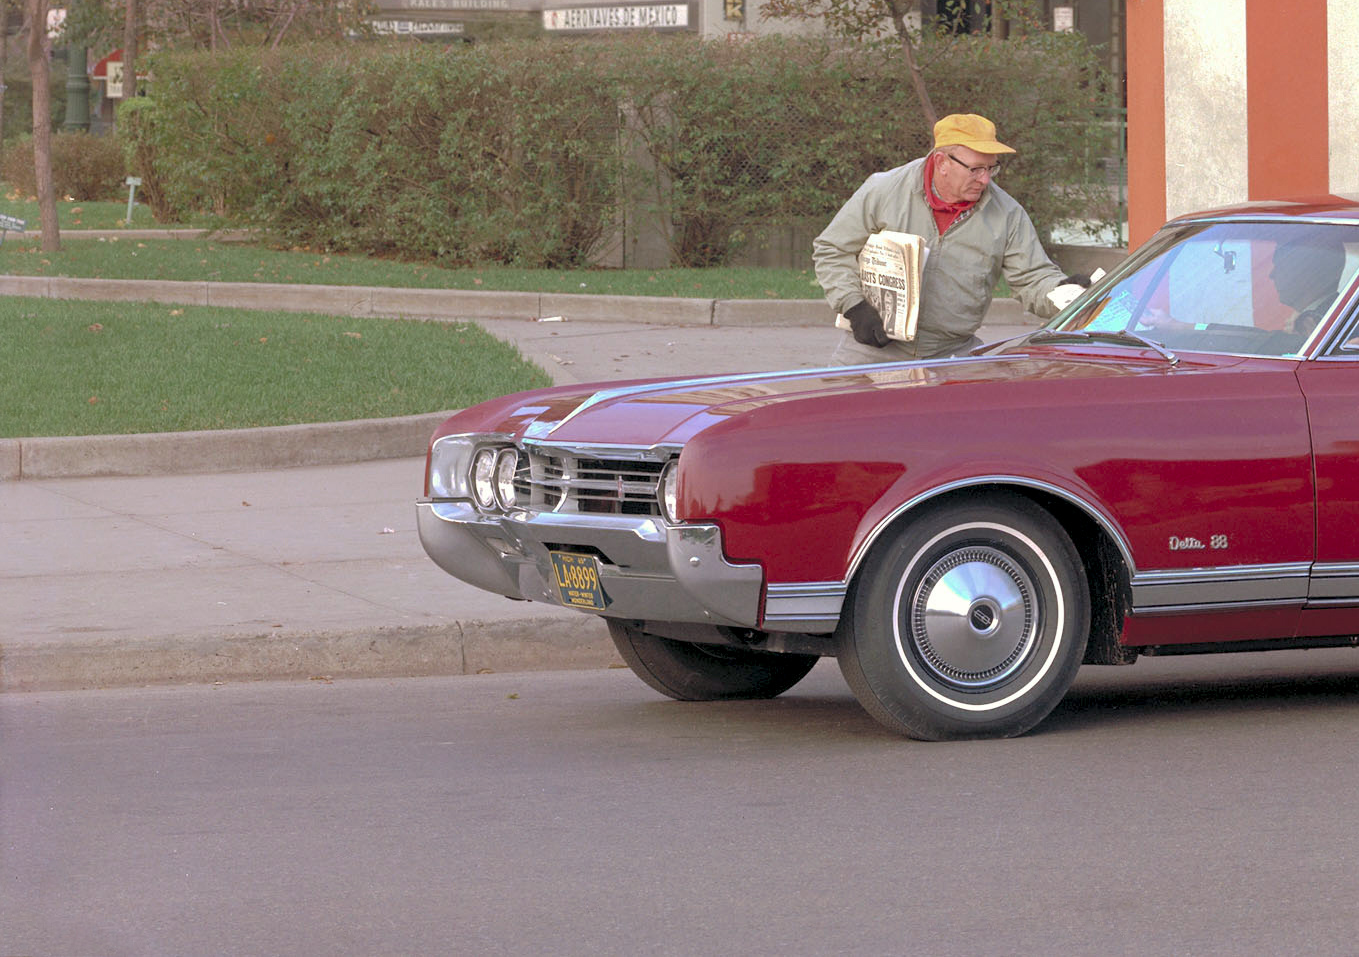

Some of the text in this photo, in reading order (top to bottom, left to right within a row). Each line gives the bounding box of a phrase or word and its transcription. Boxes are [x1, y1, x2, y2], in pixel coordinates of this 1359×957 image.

[564, 7, 622, 28] AERONAVES
[624, 7, 636, 26] DE
[878, 273, 905, 290] CONGRESS
[1169, 534, 1229, 551] Delta 88
